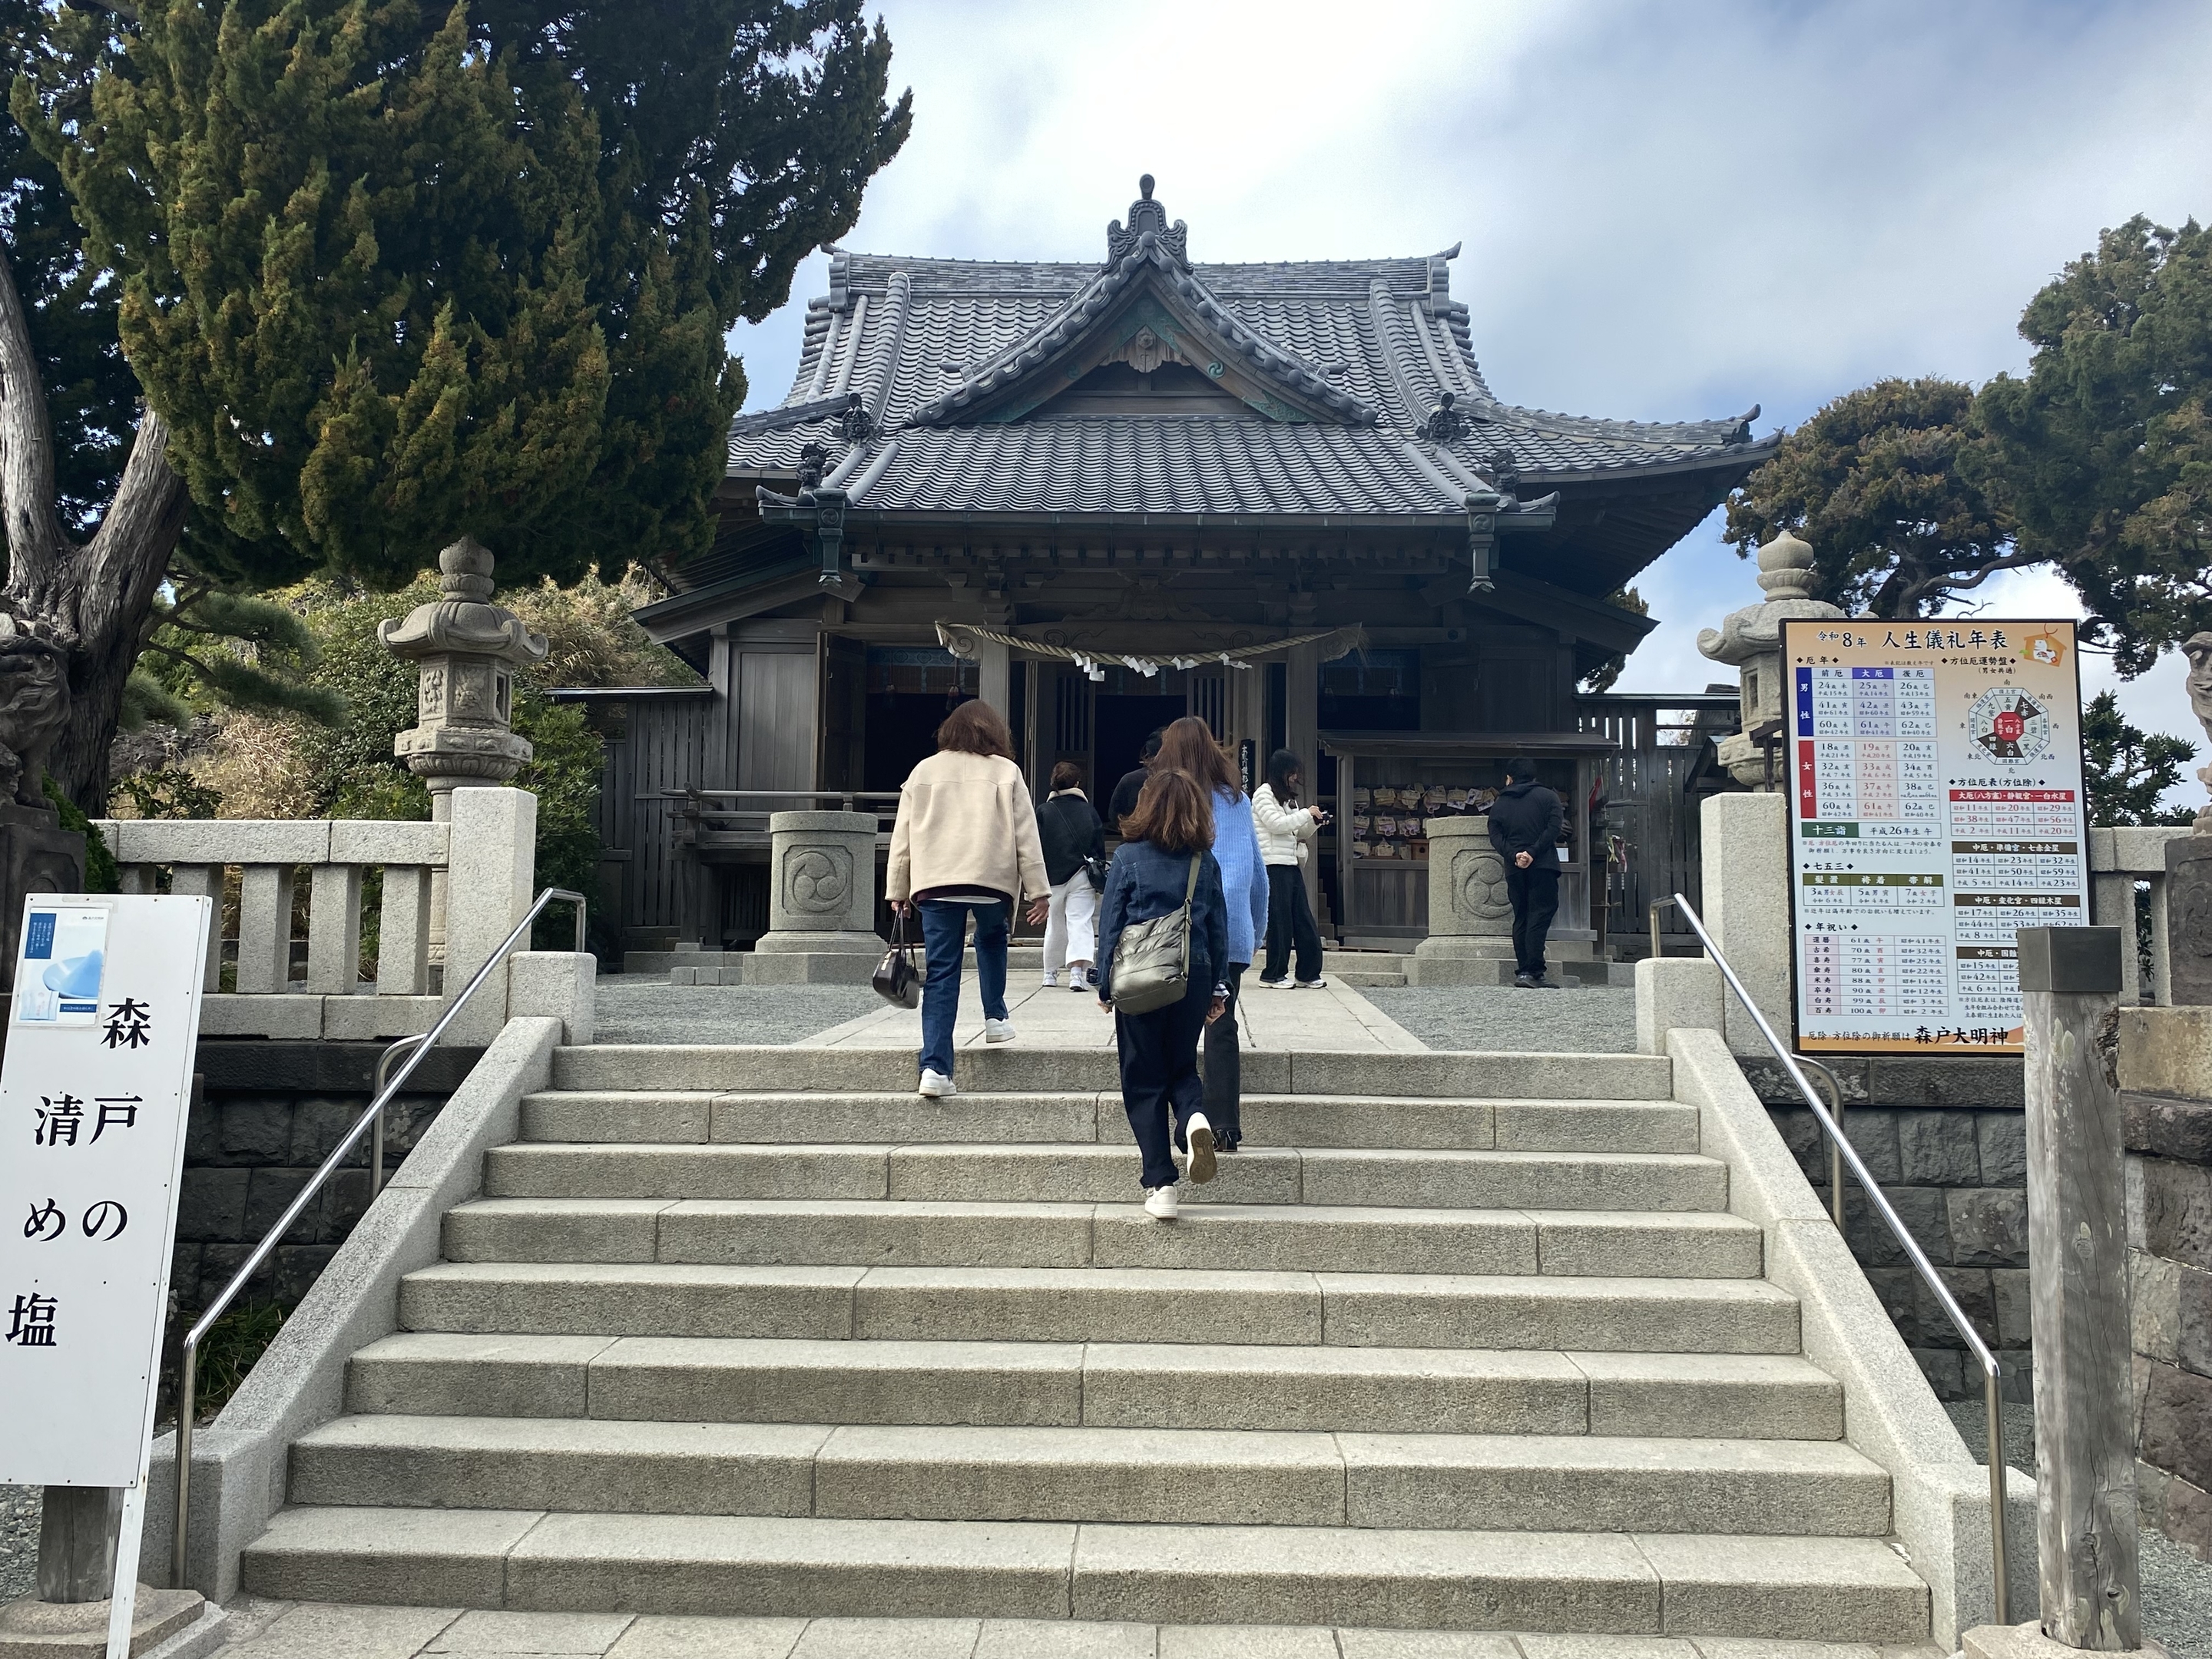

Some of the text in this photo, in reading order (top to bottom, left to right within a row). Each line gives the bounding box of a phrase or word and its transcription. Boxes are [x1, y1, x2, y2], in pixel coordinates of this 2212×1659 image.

[1817, 630, 2008, 650] 令和8年 人生儀礼年表
[1806, 656, 1829, 664] 厄年
[1950, 657, 2008, 666] 方位厄運勢盤
[1958, 778, 2035, 786] 方位厄表(方位除)
[1870, 826, 1920, 835] 平成26年生
[1816, 922, 1847, 931] 年祝い
[1914, 1025, 2008, 1045] 森戸大明神
[81, 998, 151, 1243] 森戸の
[4, 1094, 84, 1347] 清め塩
